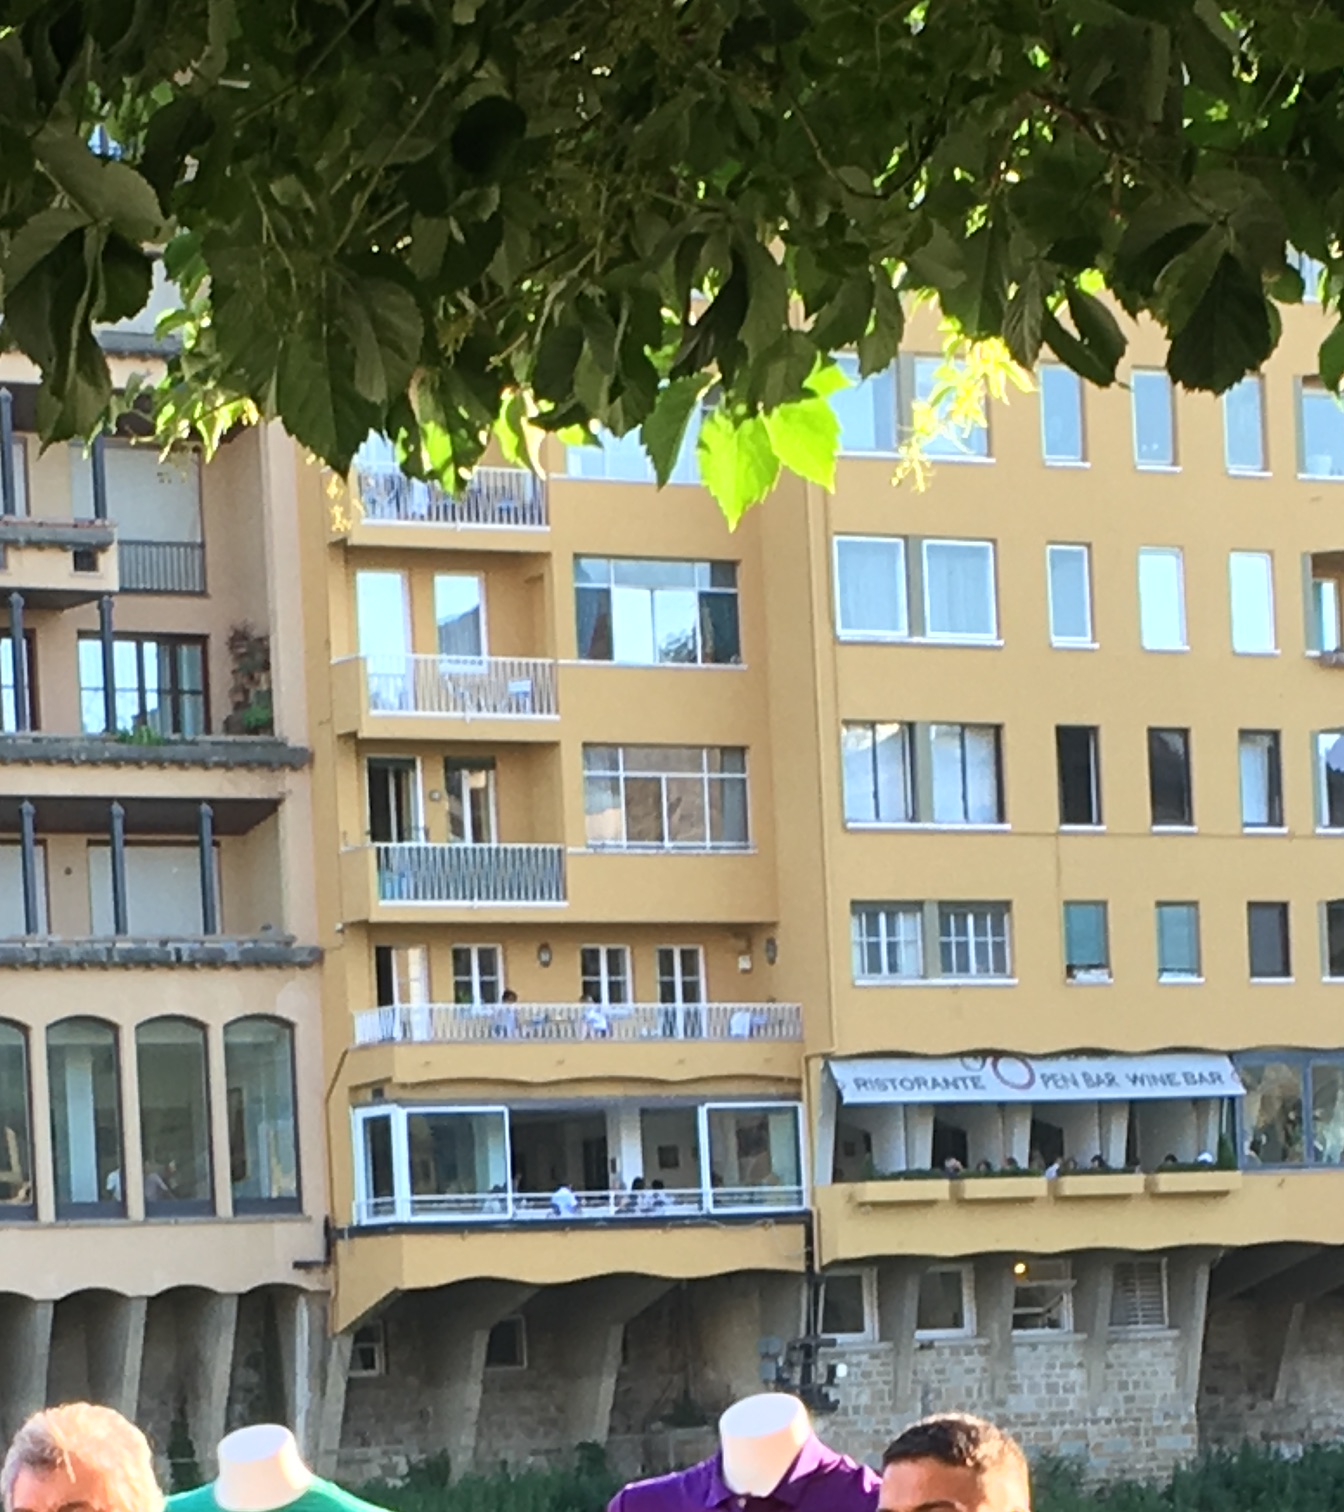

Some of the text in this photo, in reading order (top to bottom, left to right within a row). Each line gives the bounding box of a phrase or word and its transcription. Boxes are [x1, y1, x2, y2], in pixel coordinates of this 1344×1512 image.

[853, 1075, 986, 1092] RISTORANTE
[1081, 1071, 1120, 1089] BAR
[1125, 1071, 1181, 1087] WINE
[1181, 1070, 1225, 1086] BAR
